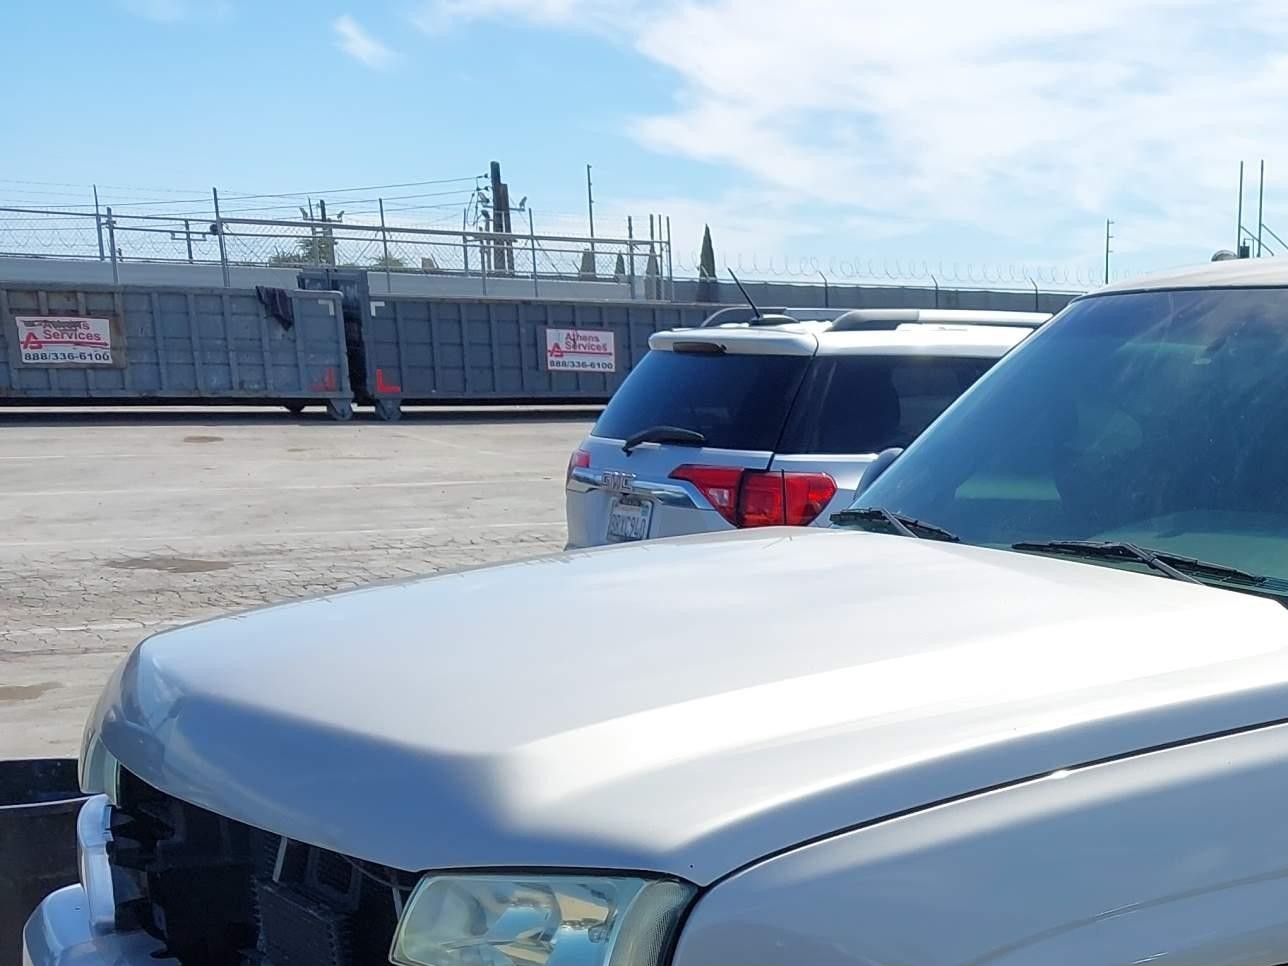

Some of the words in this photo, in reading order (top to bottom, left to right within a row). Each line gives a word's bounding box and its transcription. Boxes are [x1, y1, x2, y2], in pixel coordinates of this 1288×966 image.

[43, 330, 101, 341] Services
[565, 332, 600, 342] Athens
[564, 341, 608, 352] Services
[24, 352, 110, 361] 888/336-6100
[602, 472, 633, 491] GMC
